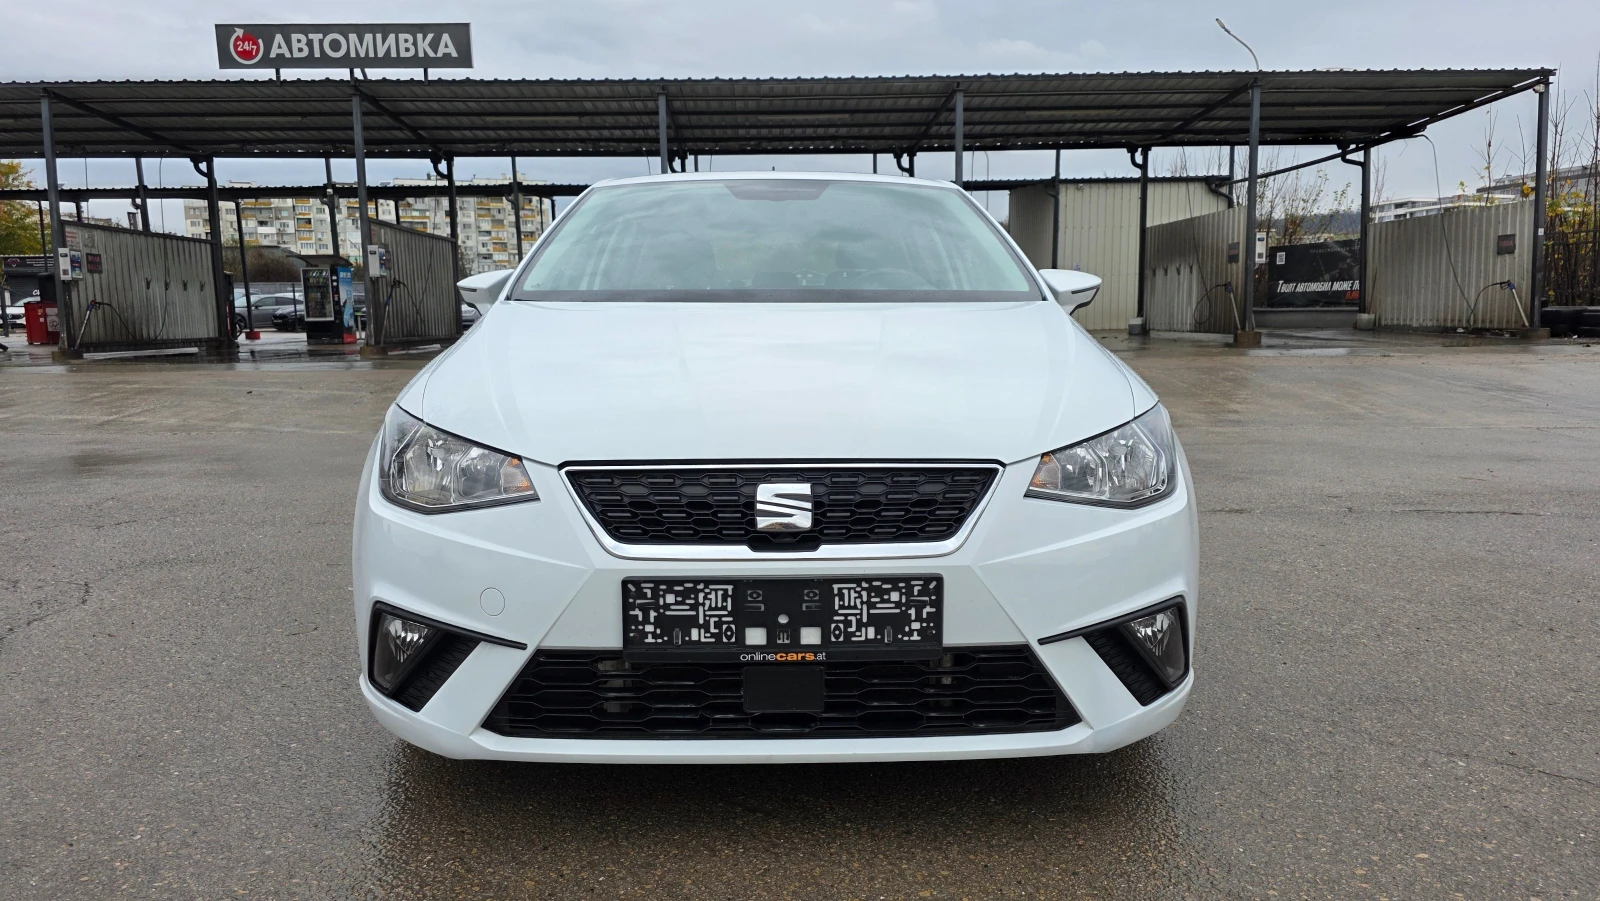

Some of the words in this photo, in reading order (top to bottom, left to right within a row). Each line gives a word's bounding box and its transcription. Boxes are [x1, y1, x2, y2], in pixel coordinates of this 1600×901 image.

[237, 40, 257, 56] 24/7
[269, 33, 459, 58] АВТОМИВКА
[1332, 280, 1354, 291] МОЖЕ
[740, 651, 827, 661] onlinecars.at
